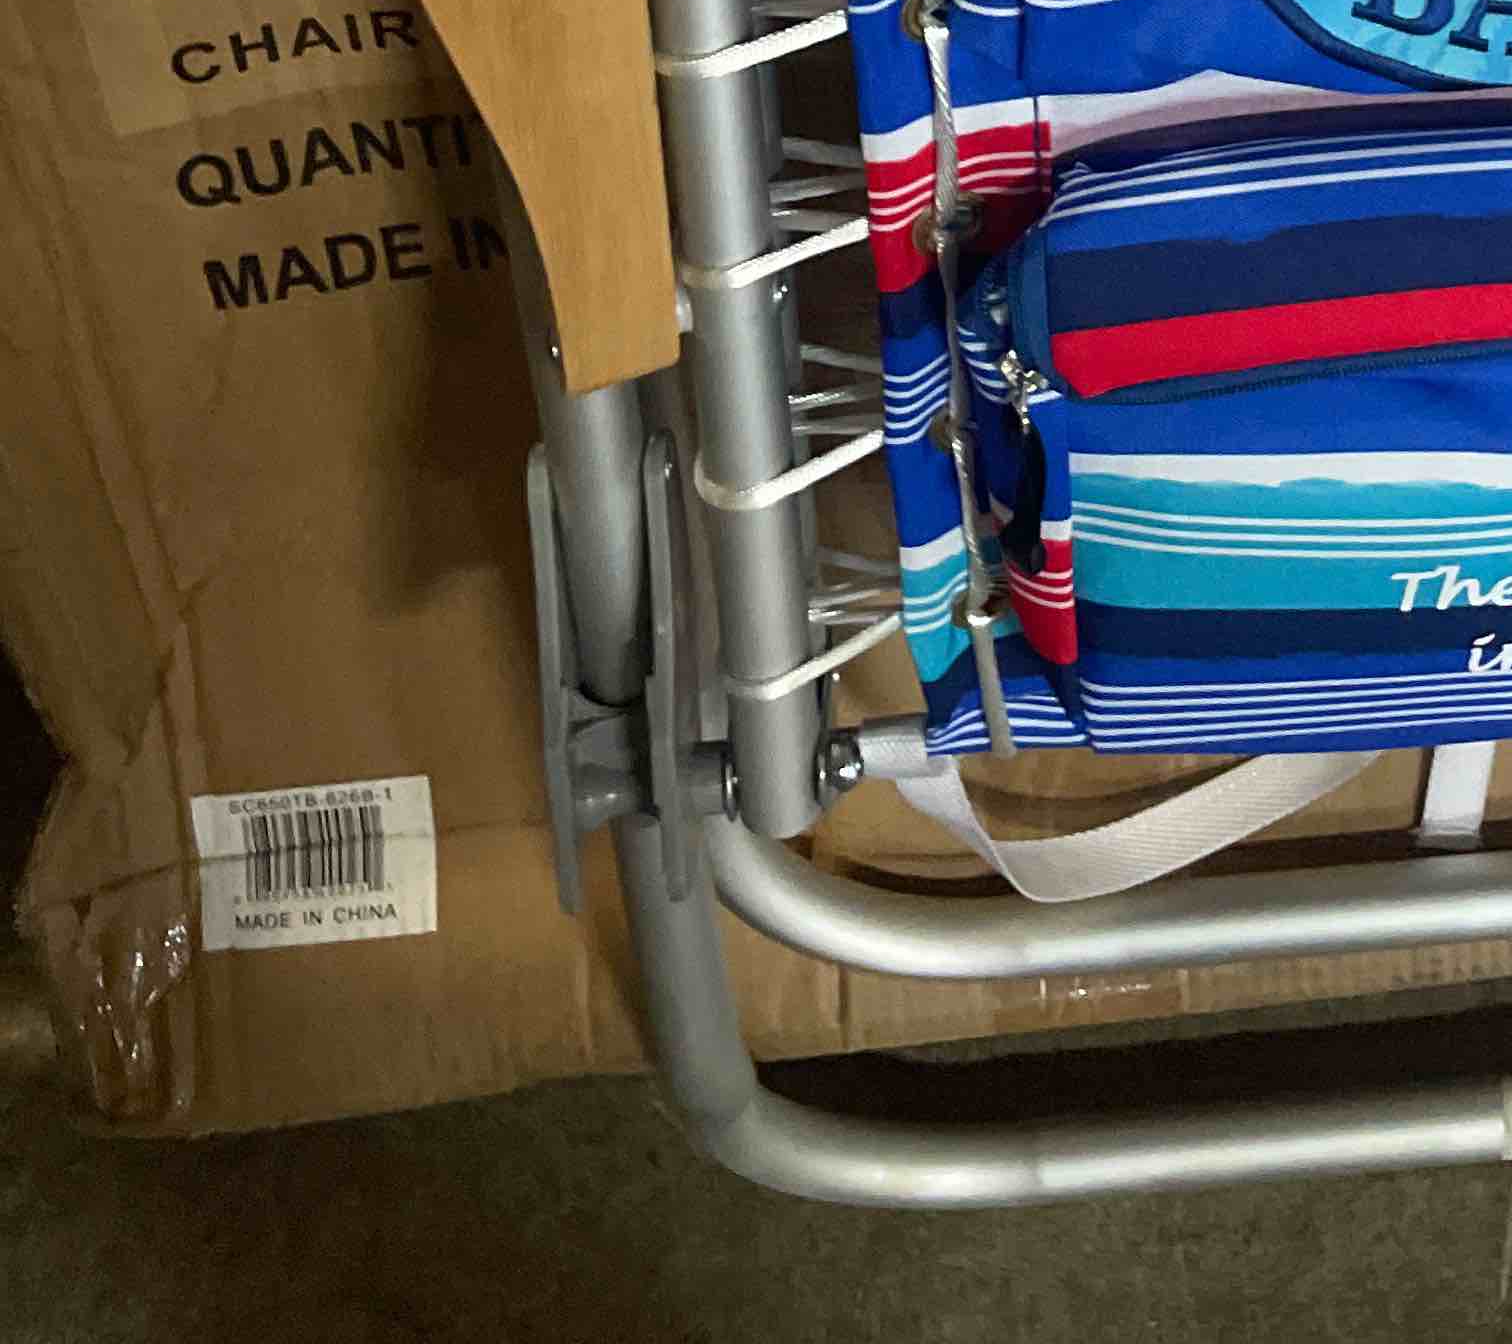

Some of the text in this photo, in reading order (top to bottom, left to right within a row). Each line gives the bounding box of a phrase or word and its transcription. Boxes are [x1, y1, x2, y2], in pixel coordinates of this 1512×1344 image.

[170, 8, 419, 85] CHAIR
[202, 221, 433, 311] MADE
[234, 902, 399, 931] MADE IN CHINA
